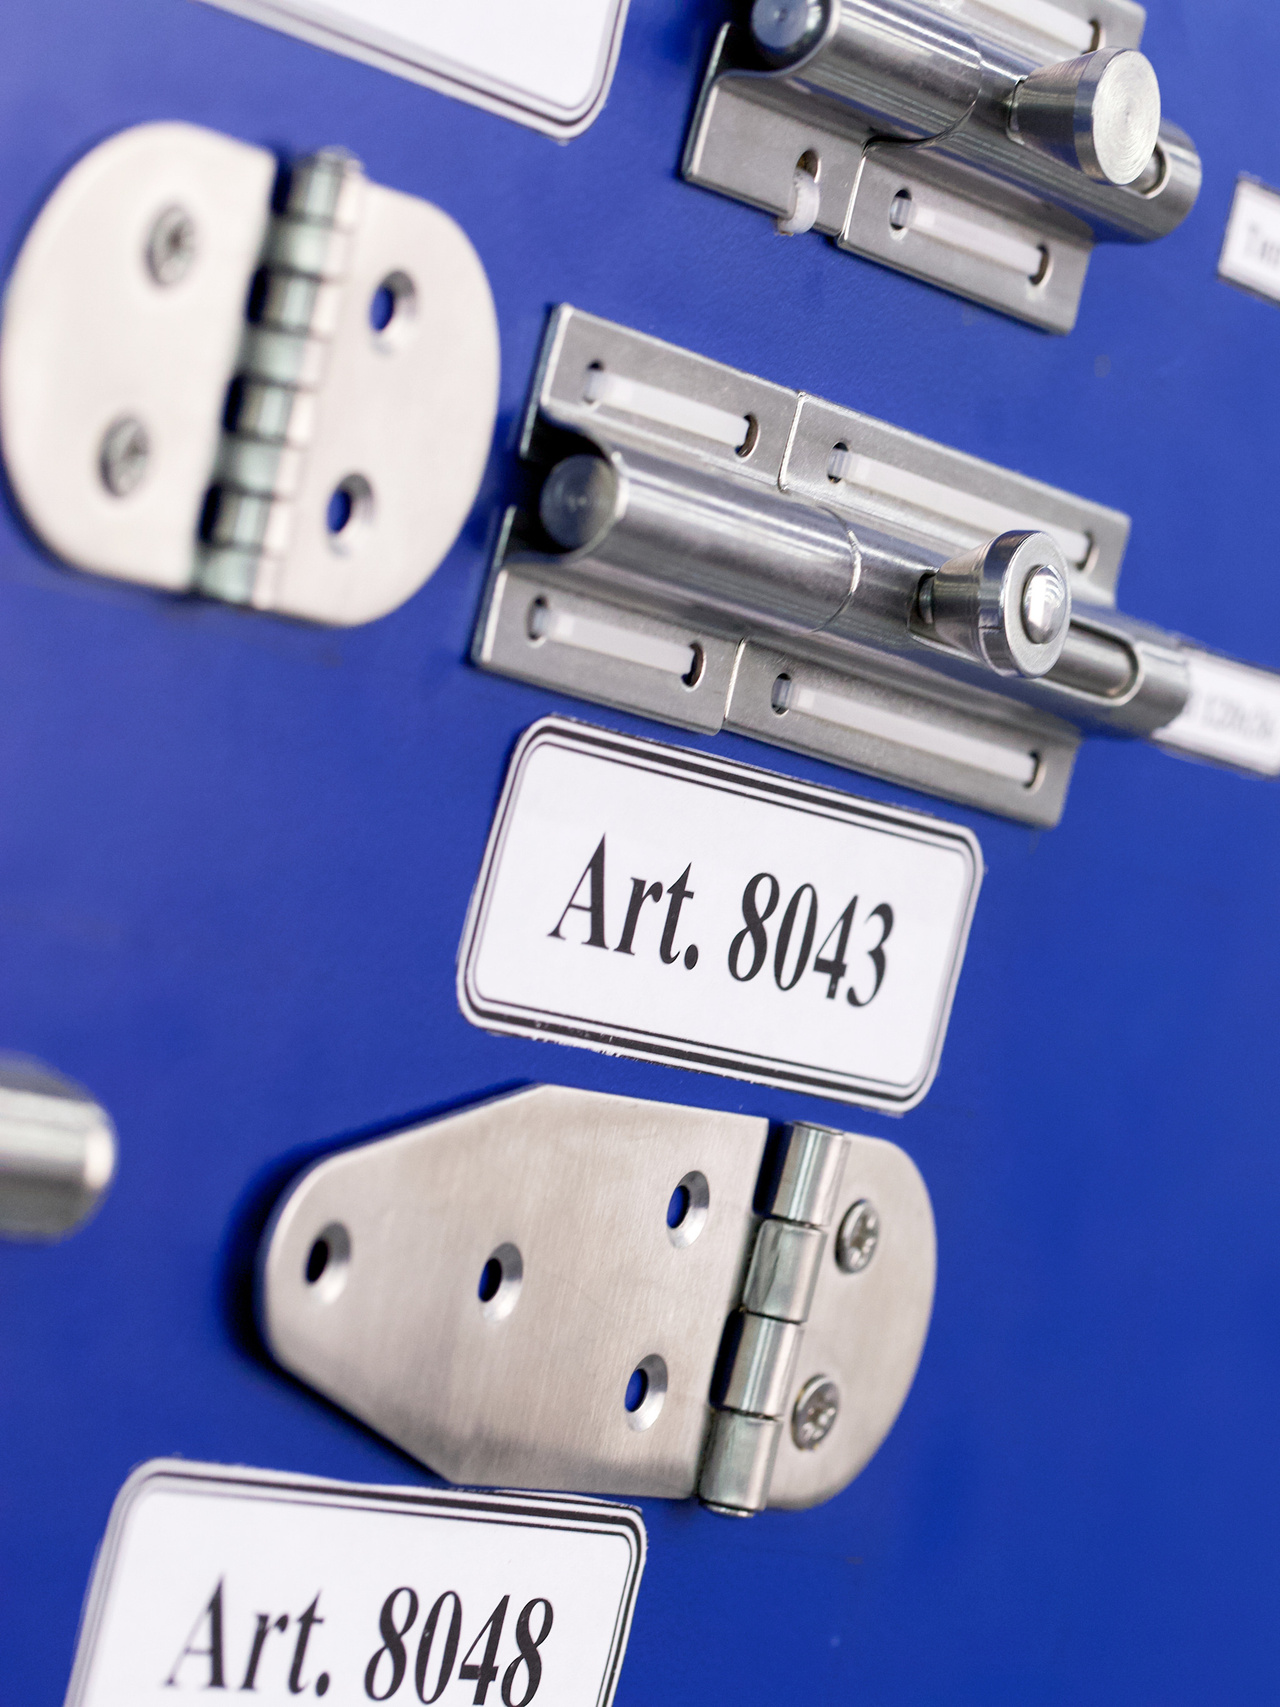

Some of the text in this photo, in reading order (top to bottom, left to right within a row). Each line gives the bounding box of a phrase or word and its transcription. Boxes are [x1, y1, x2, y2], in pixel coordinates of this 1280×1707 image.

[547, 832, 895, 1008] Art. 8043
[164, 1574, 554, 1707] Art. 8048
